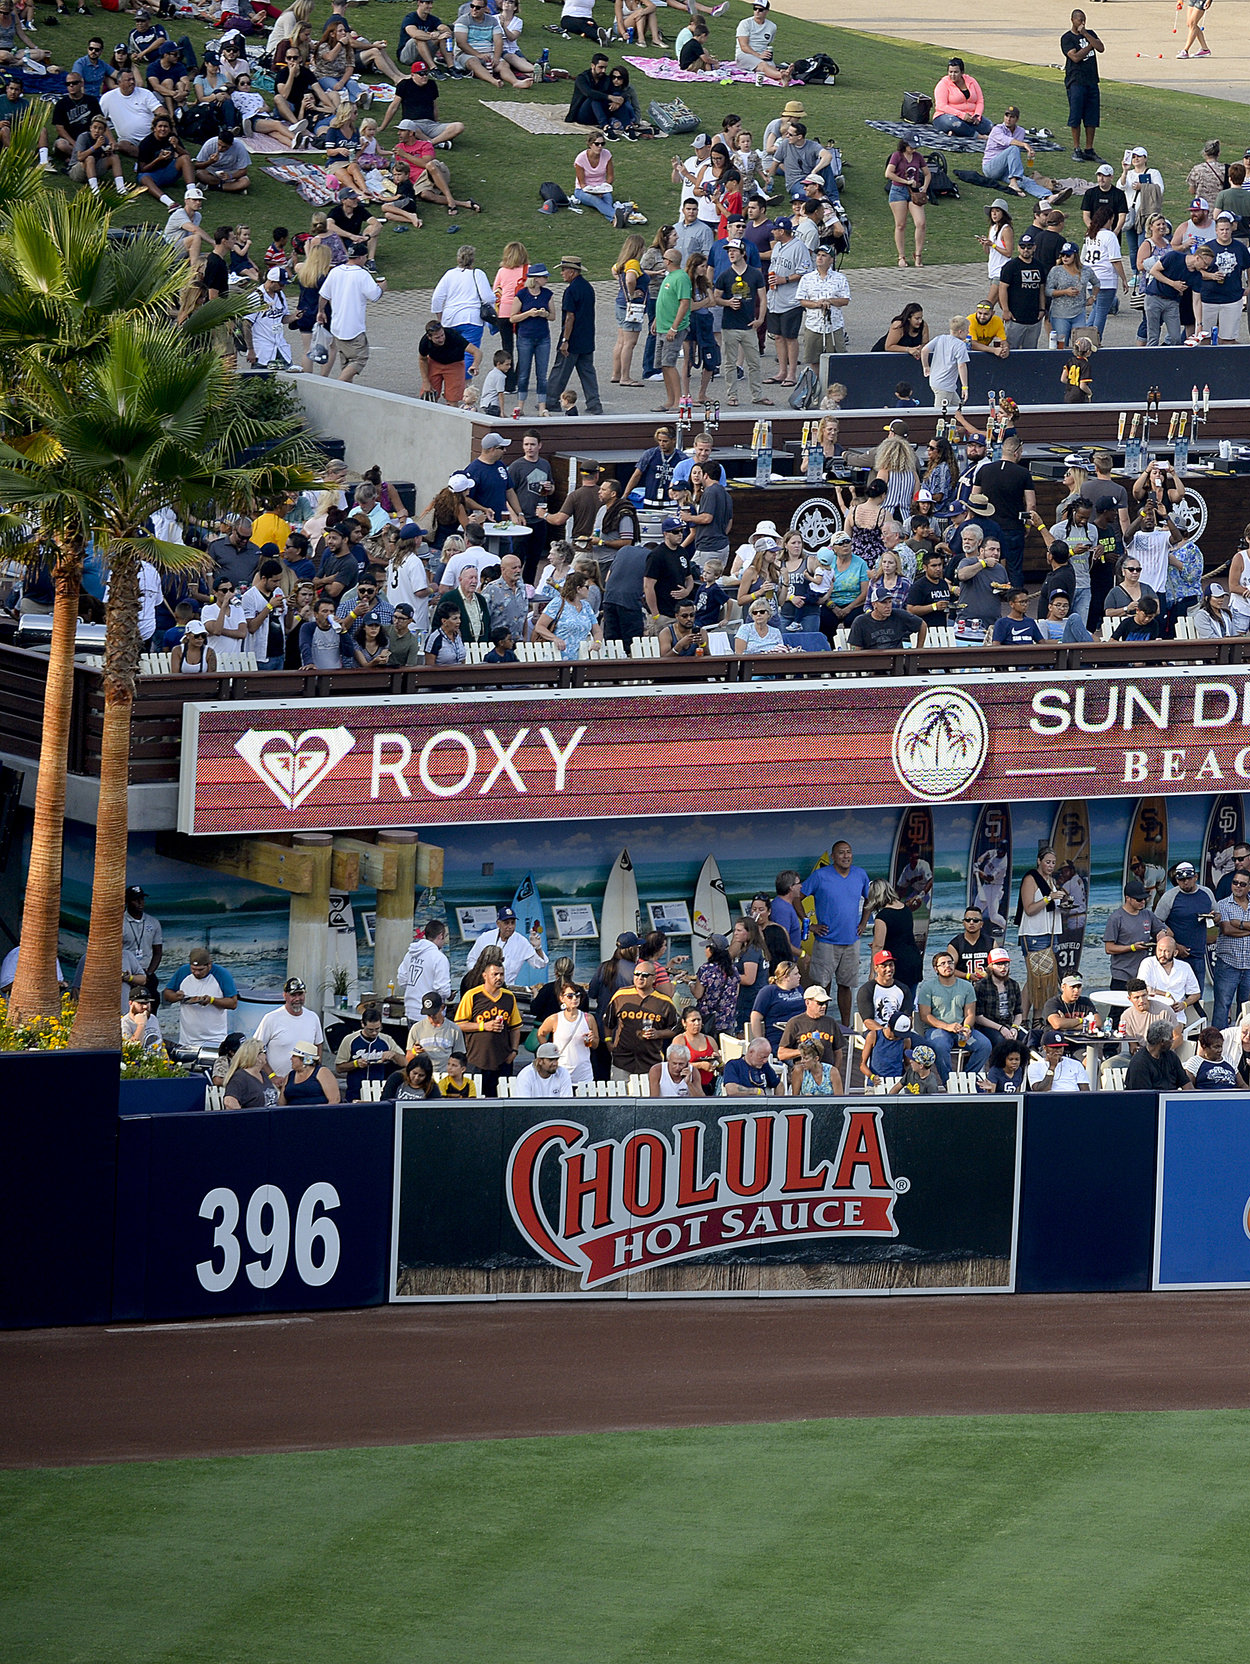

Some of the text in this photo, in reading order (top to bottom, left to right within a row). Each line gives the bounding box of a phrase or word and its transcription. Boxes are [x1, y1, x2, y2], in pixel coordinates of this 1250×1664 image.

[1029, 684, 1170, 736] SUN
[371, 726, 588, 799] ROXY
[409, 964, 423, 987] 17
[966, 959, 985, 975] 15
[1059, 950, 1075, 967] 31
[621, 1010, 662, 1022] padres
[508, 1109, 897, 1269] CHOLULA
[195, 1181, 341, 1293] 396
[612, 1200, 866, 1269] HOT SAUCE
